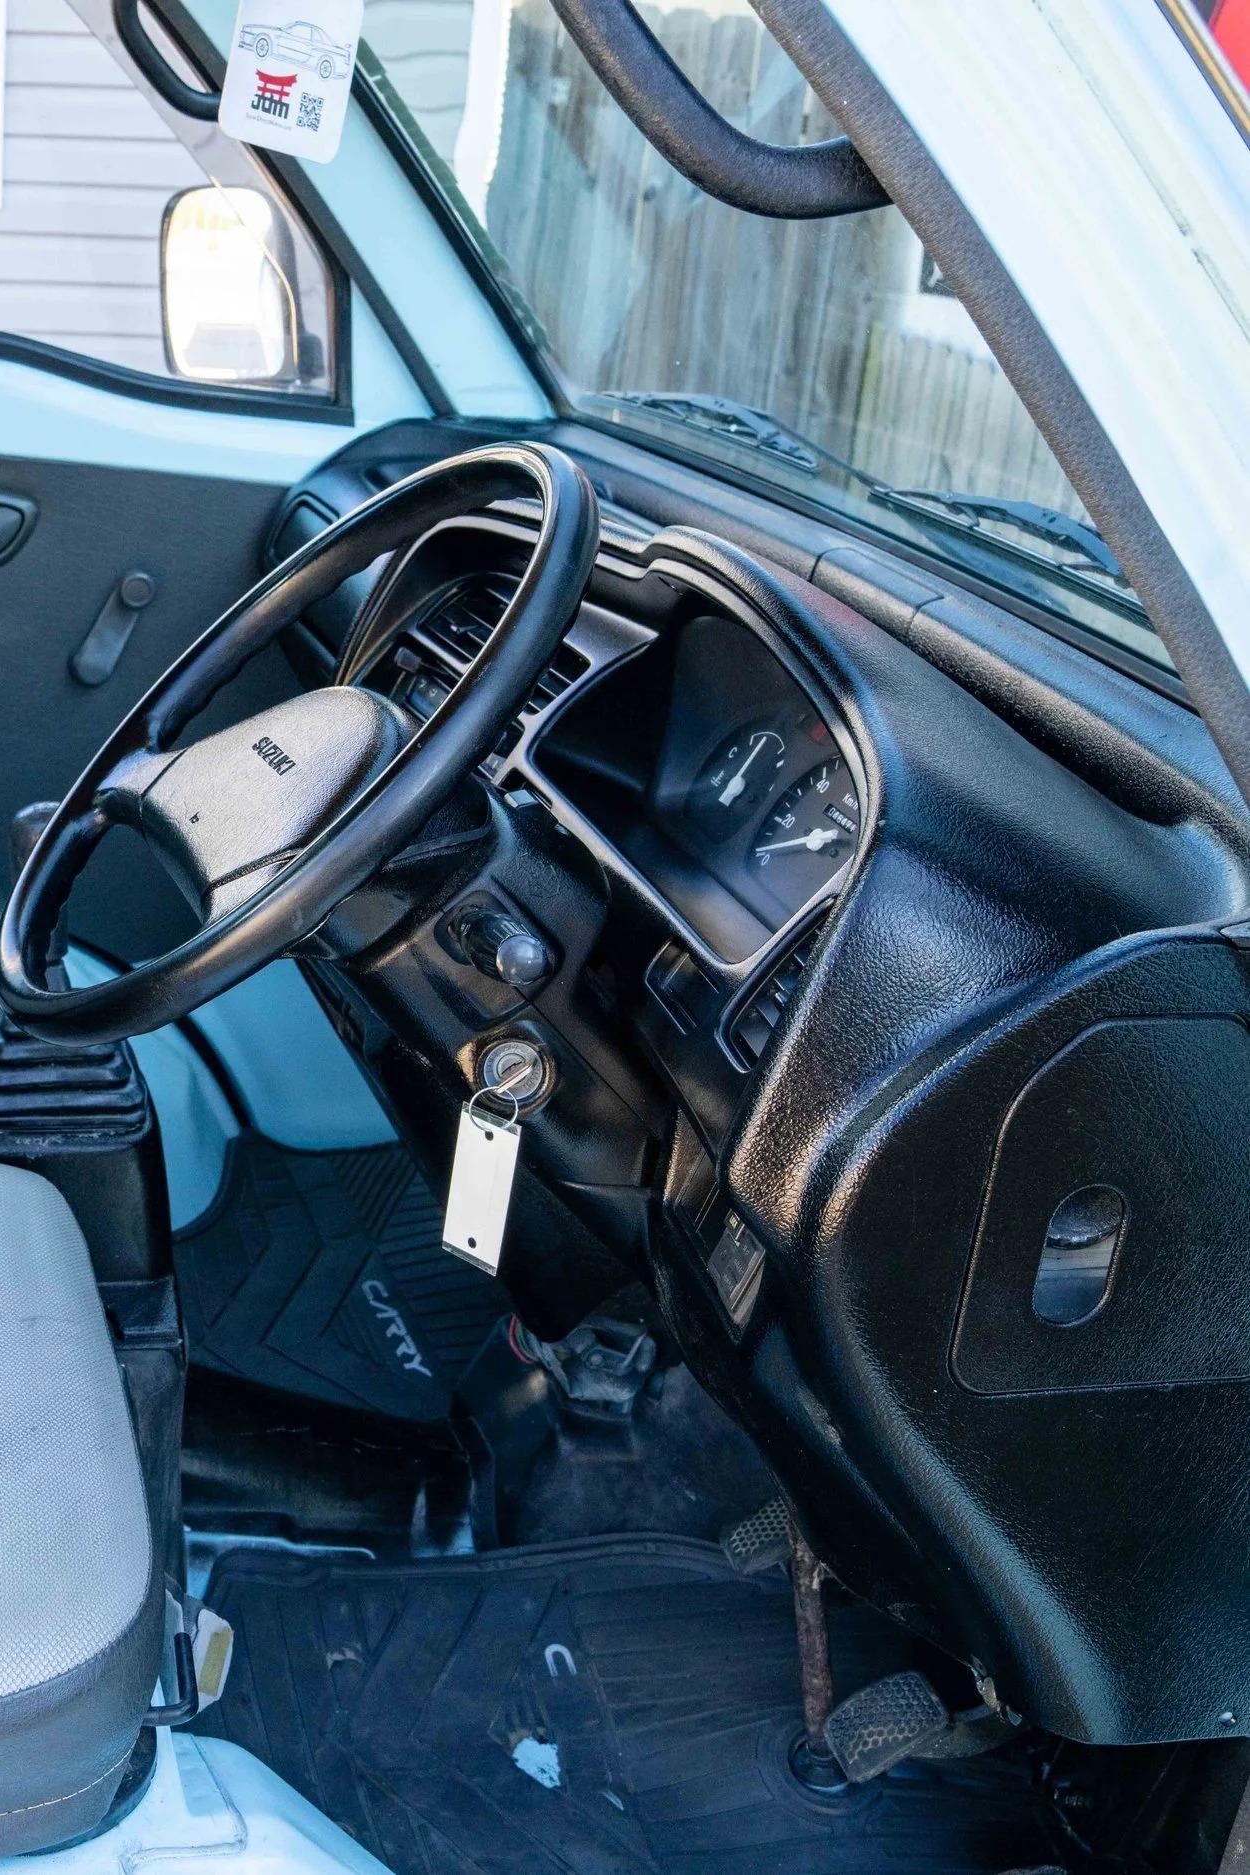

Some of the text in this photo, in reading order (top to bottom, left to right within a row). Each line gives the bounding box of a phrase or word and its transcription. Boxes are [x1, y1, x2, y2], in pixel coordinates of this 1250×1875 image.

[252, 736, 296, 776] SUZUKI
[816, 779, 830, 794] 40
[781, 813, 796, 829] 20
[761, 854, 770, 866] 0
[361, 1279, 433, 1377] CARRY
